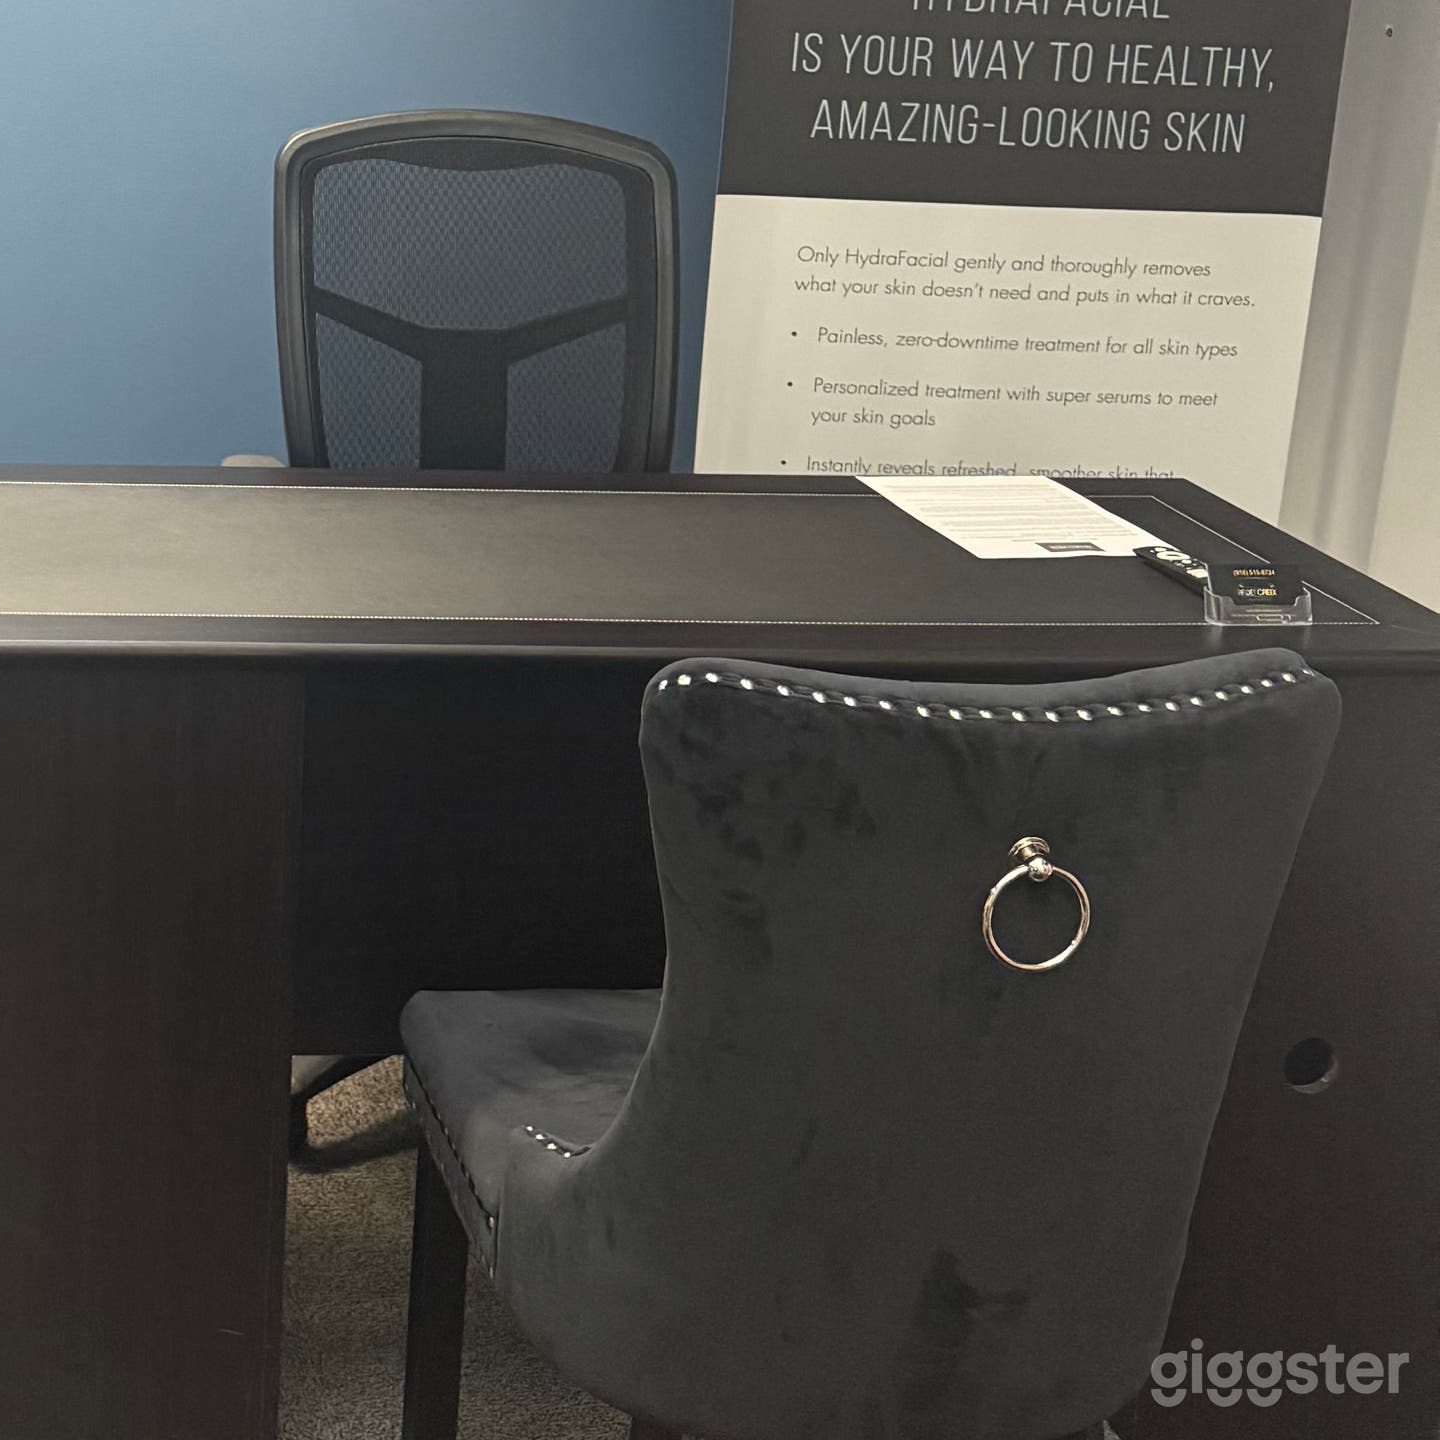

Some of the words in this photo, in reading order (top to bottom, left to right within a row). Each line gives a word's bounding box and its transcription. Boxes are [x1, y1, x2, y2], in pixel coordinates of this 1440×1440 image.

[791, 31, 824, 73] IS
[840, 33, 934, 77] YOUR
[951, 37, 1035, 81] WAY
[1049, 41, 1094, 83] TO
[1106, 43, 1274, 92] HEALTHY,
[810, 98, 1151, 151] AMAZING-LOOKING
[1164, 111, 1246, 153] SKIN
[797, 245, 840, 269] Only
[844, 247, 949, 270] HydraFacial
[953, 252, 1007, 275] gently
[1010, 253, 1045, 272] and
[1050, 254, 1138, 280] thoroughly
[1142, 262, 1211, 277] removes
[794, 274, 837, 293] what
[841, 280, 879, 298] your
[883, 277, 916, 296] skin
[921, 279, 984, 299] doesn't
[988, 282, 1032, 301] need
[1036, 283, 1071, 302] and
[1075, 287, 1109, 307] puts
[1115, 288, 1130, 304] in
[1135, 286, 1178, 305] what
[1182, 289, 1193, 305] it
[1197, 292, 1256, 307] craves.
[817, 326, 888, 348] Painless,
[895, 330, 1020, 351] zero-downtime
[1025, 335, 1101, 353] treatment
[1105, 335, 1128, 354] for
[1133, 337, 1154, 355] all
[1158, 337, 1190, 356] skin
[1195, 341, 1238, 361] types
[813, 376, 919, 397] Personalized
[925, 382, 1001, 400] treatment
[1006, 384, 1041, 401] with
[1045, 391, 1092, 407] super
[1095, 391, 1152, 405] serums
[1157, 391, 1174, 406] to
[1178, 391, 1219, 407] meet
[810, 410, 848, 427] your
[852, 406, 884, 425] skin
[889, 408, 936, 430] goals
[806, 455, 872, 474] Instantly
[877, 459, 936, 475] reveals
